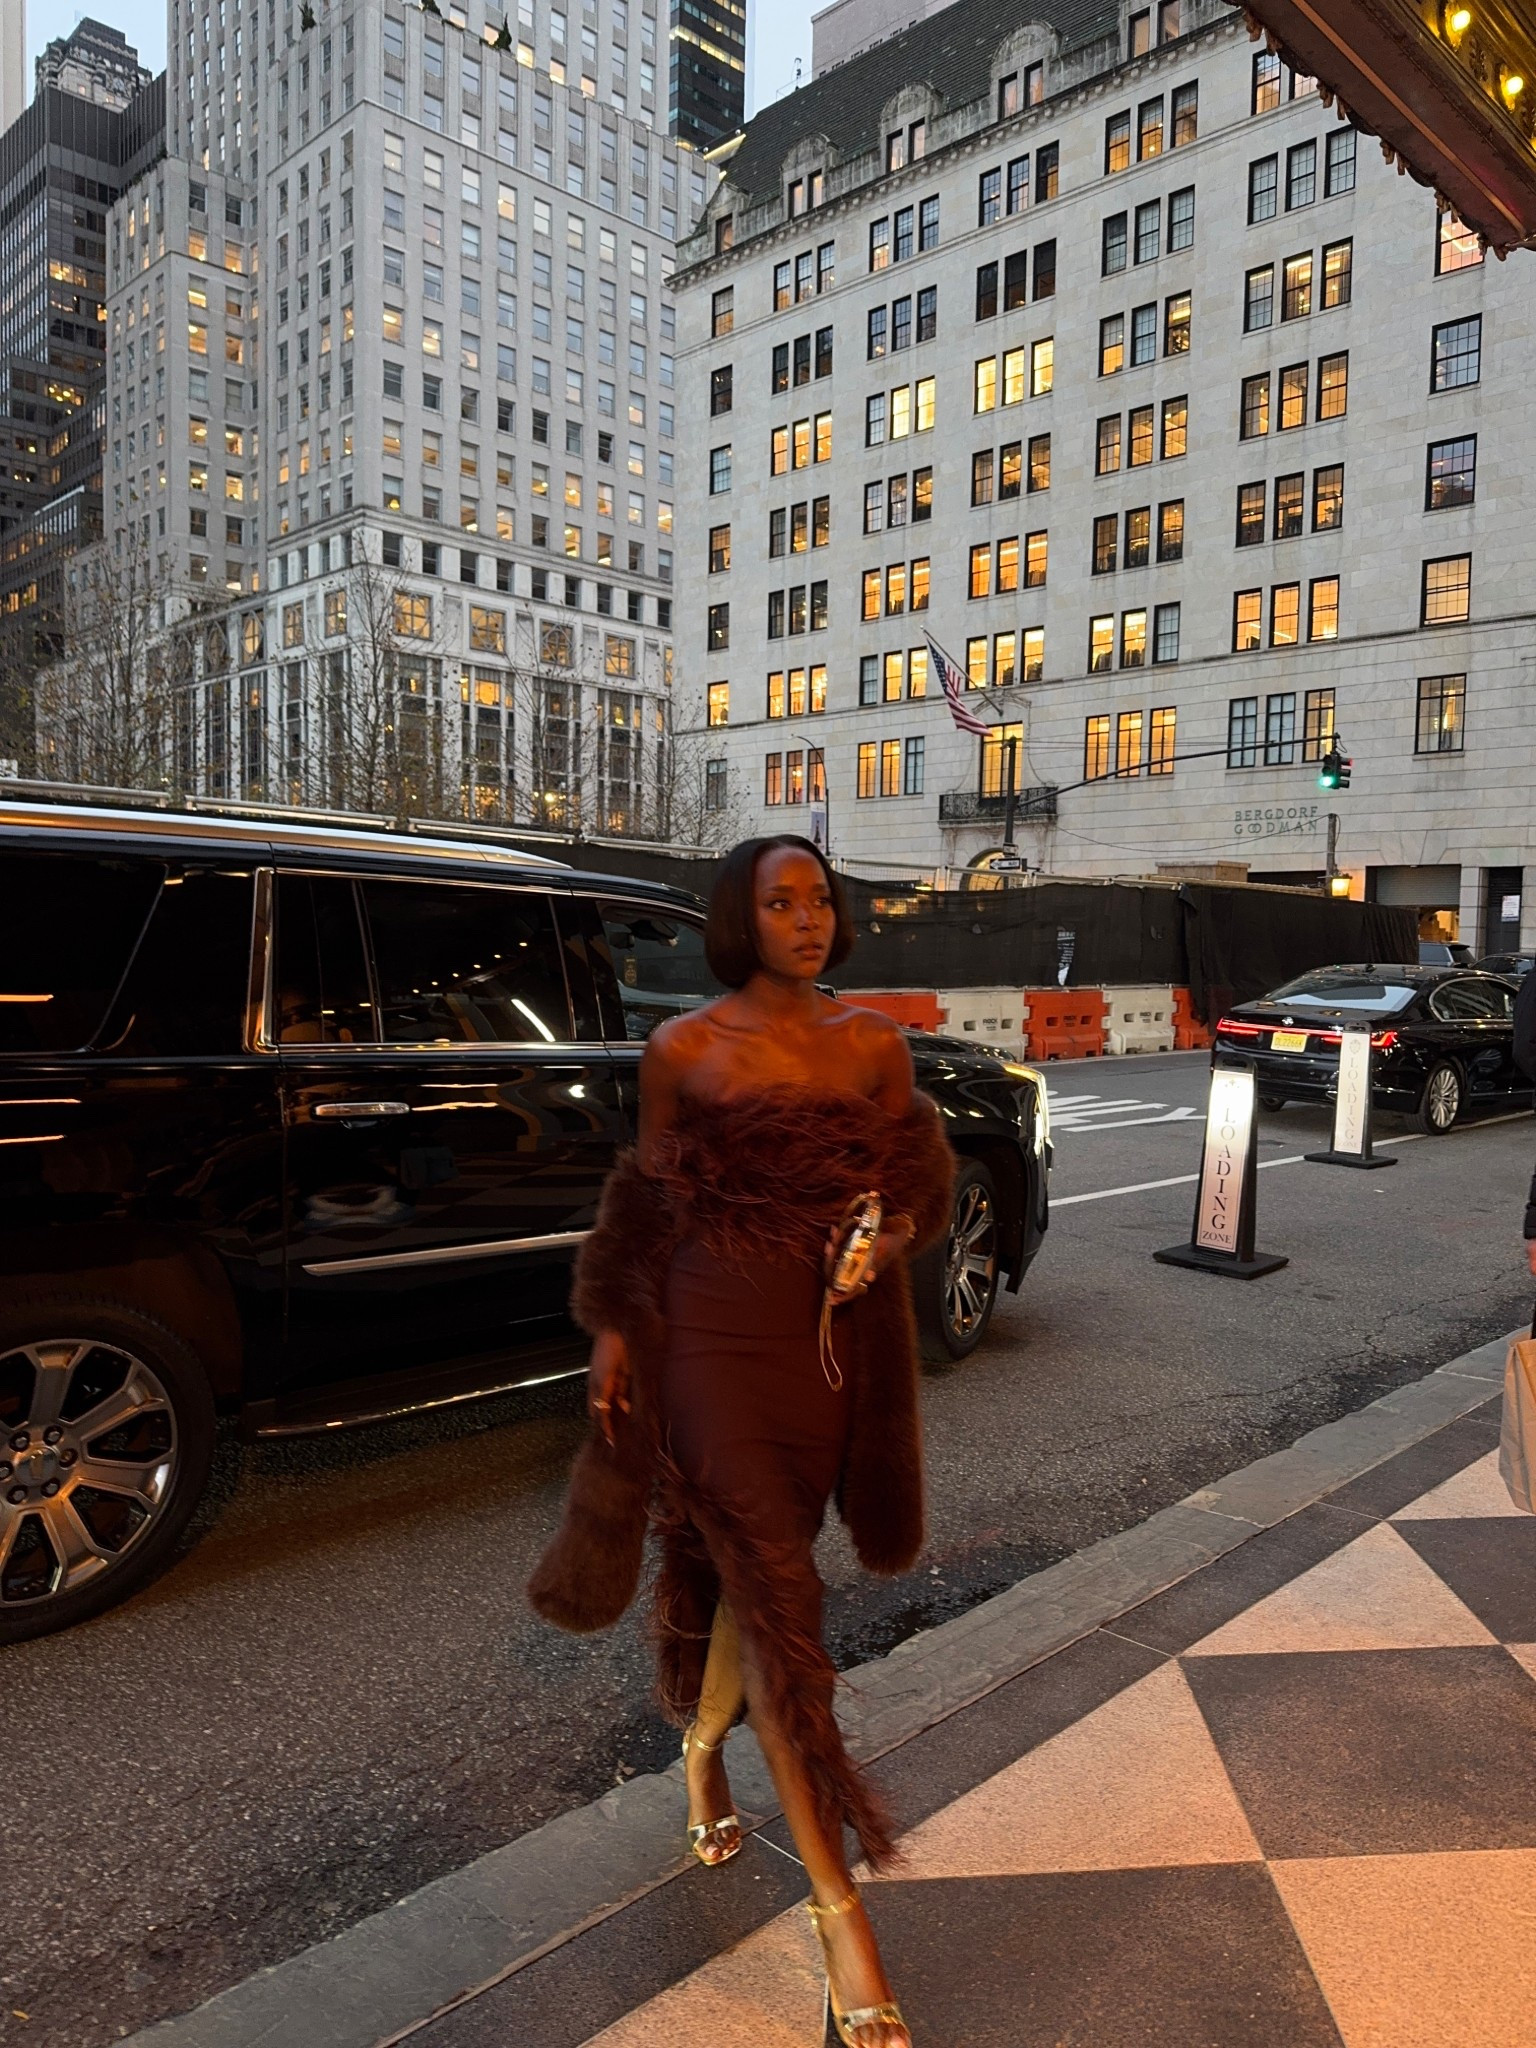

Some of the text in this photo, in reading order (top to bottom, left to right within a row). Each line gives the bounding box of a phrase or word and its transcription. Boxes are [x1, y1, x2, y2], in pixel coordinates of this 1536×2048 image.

[1235, 806, 1318, 822] BERGDORF
[1234, 821, 1317, 835] GOODMAN
[1345, 1058, 1359, 1139] LOADING
[1211, 1107, 1235, 1230] LOADING
[1202, 1230, 1232, 1244] ZONE
